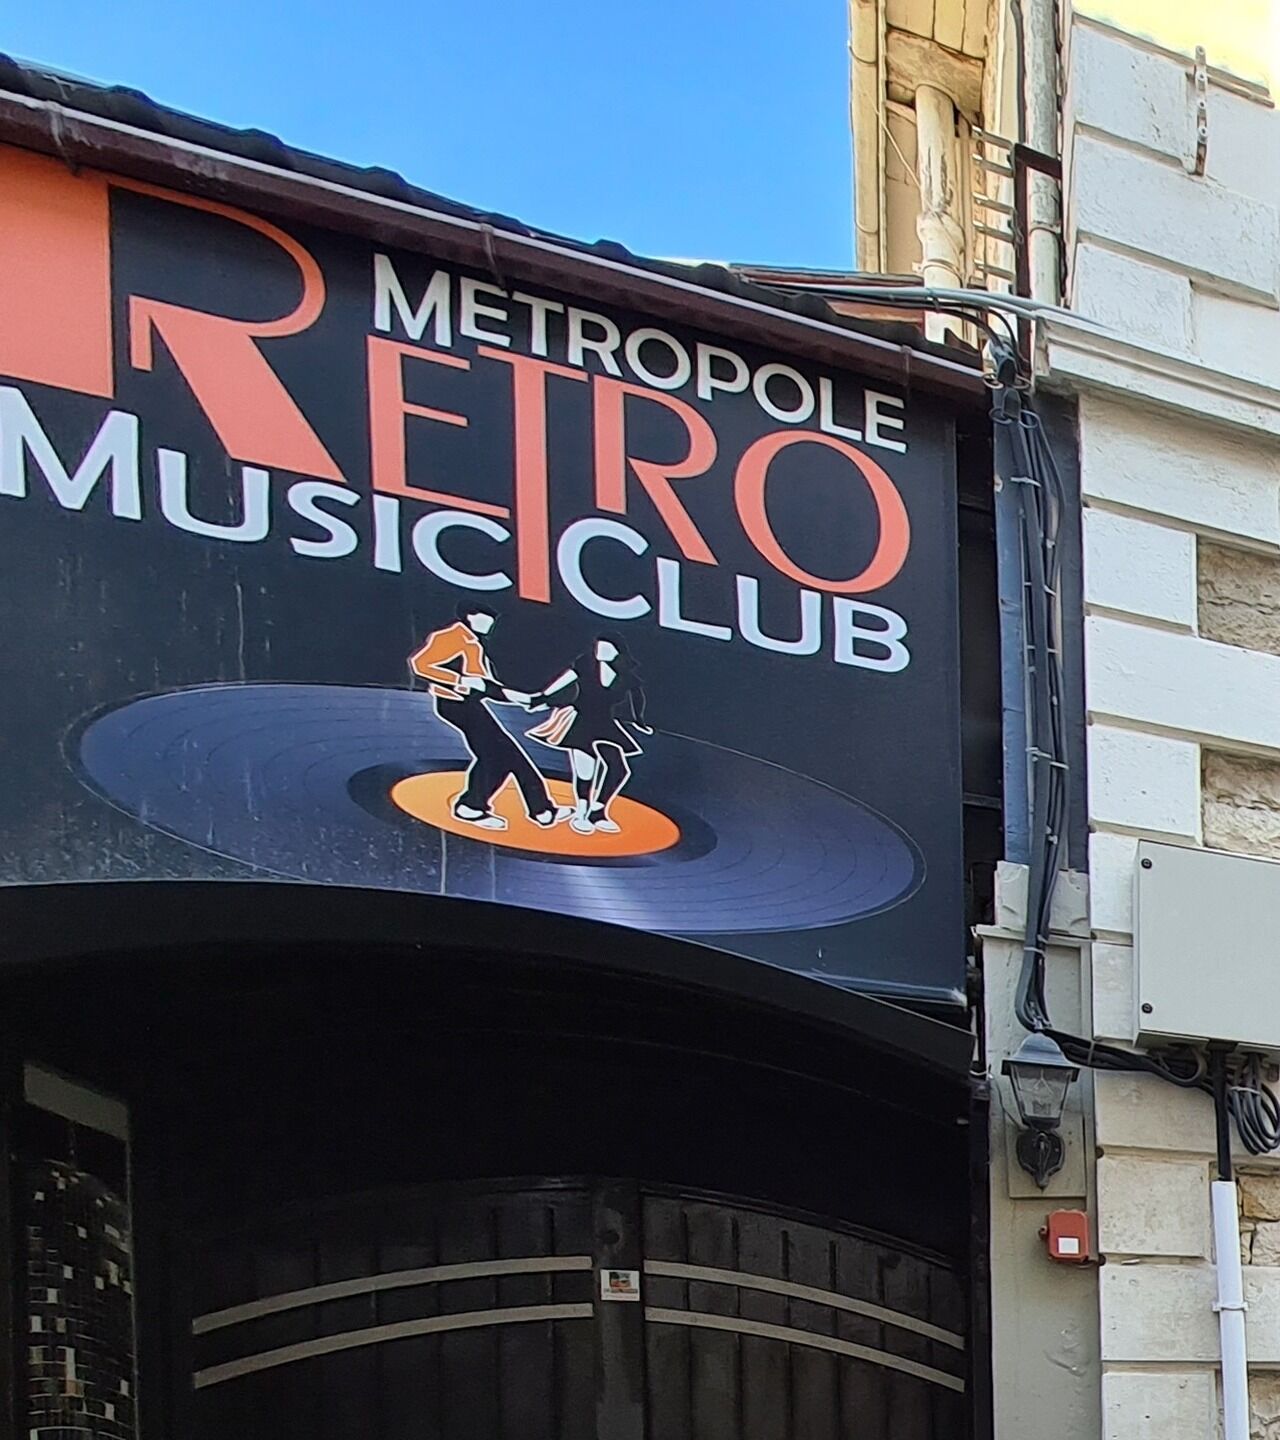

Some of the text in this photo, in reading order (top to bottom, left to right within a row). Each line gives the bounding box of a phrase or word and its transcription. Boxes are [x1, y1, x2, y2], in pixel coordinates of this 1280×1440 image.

[0, 140, 911, 603] RETRO
[374, 253, 907, 453] METROPOLE
[0, 384, 911, 673] MUSIC CLUB
